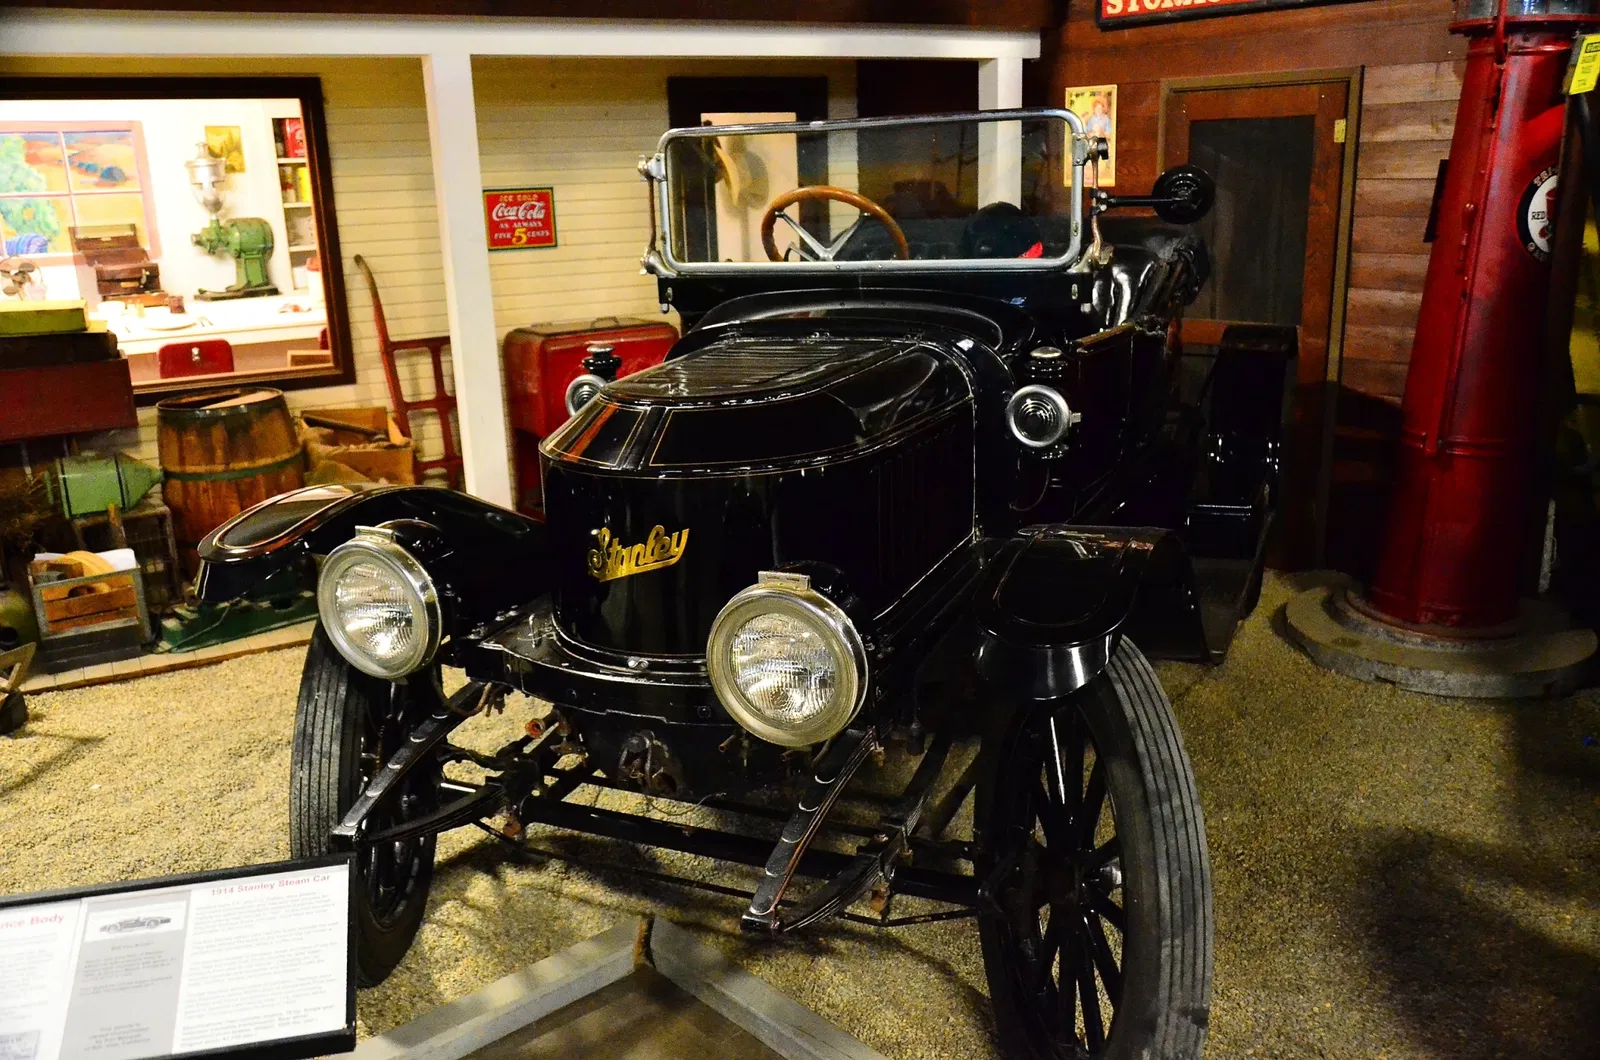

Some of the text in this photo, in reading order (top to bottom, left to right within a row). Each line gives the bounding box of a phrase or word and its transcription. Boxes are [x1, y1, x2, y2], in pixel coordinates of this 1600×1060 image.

[492, 201, 545, 221] Coca-Cola
[1531, 211, 1546, 220] RED
[512, 228, 528, 245] 5
[527, 230, 550, 238] CENTS
[588, 524, 690, 582] Stanley
[211, 875, 331, 897] 1914 Stanley Steam Car
[30, 913, 65, 925] Body
